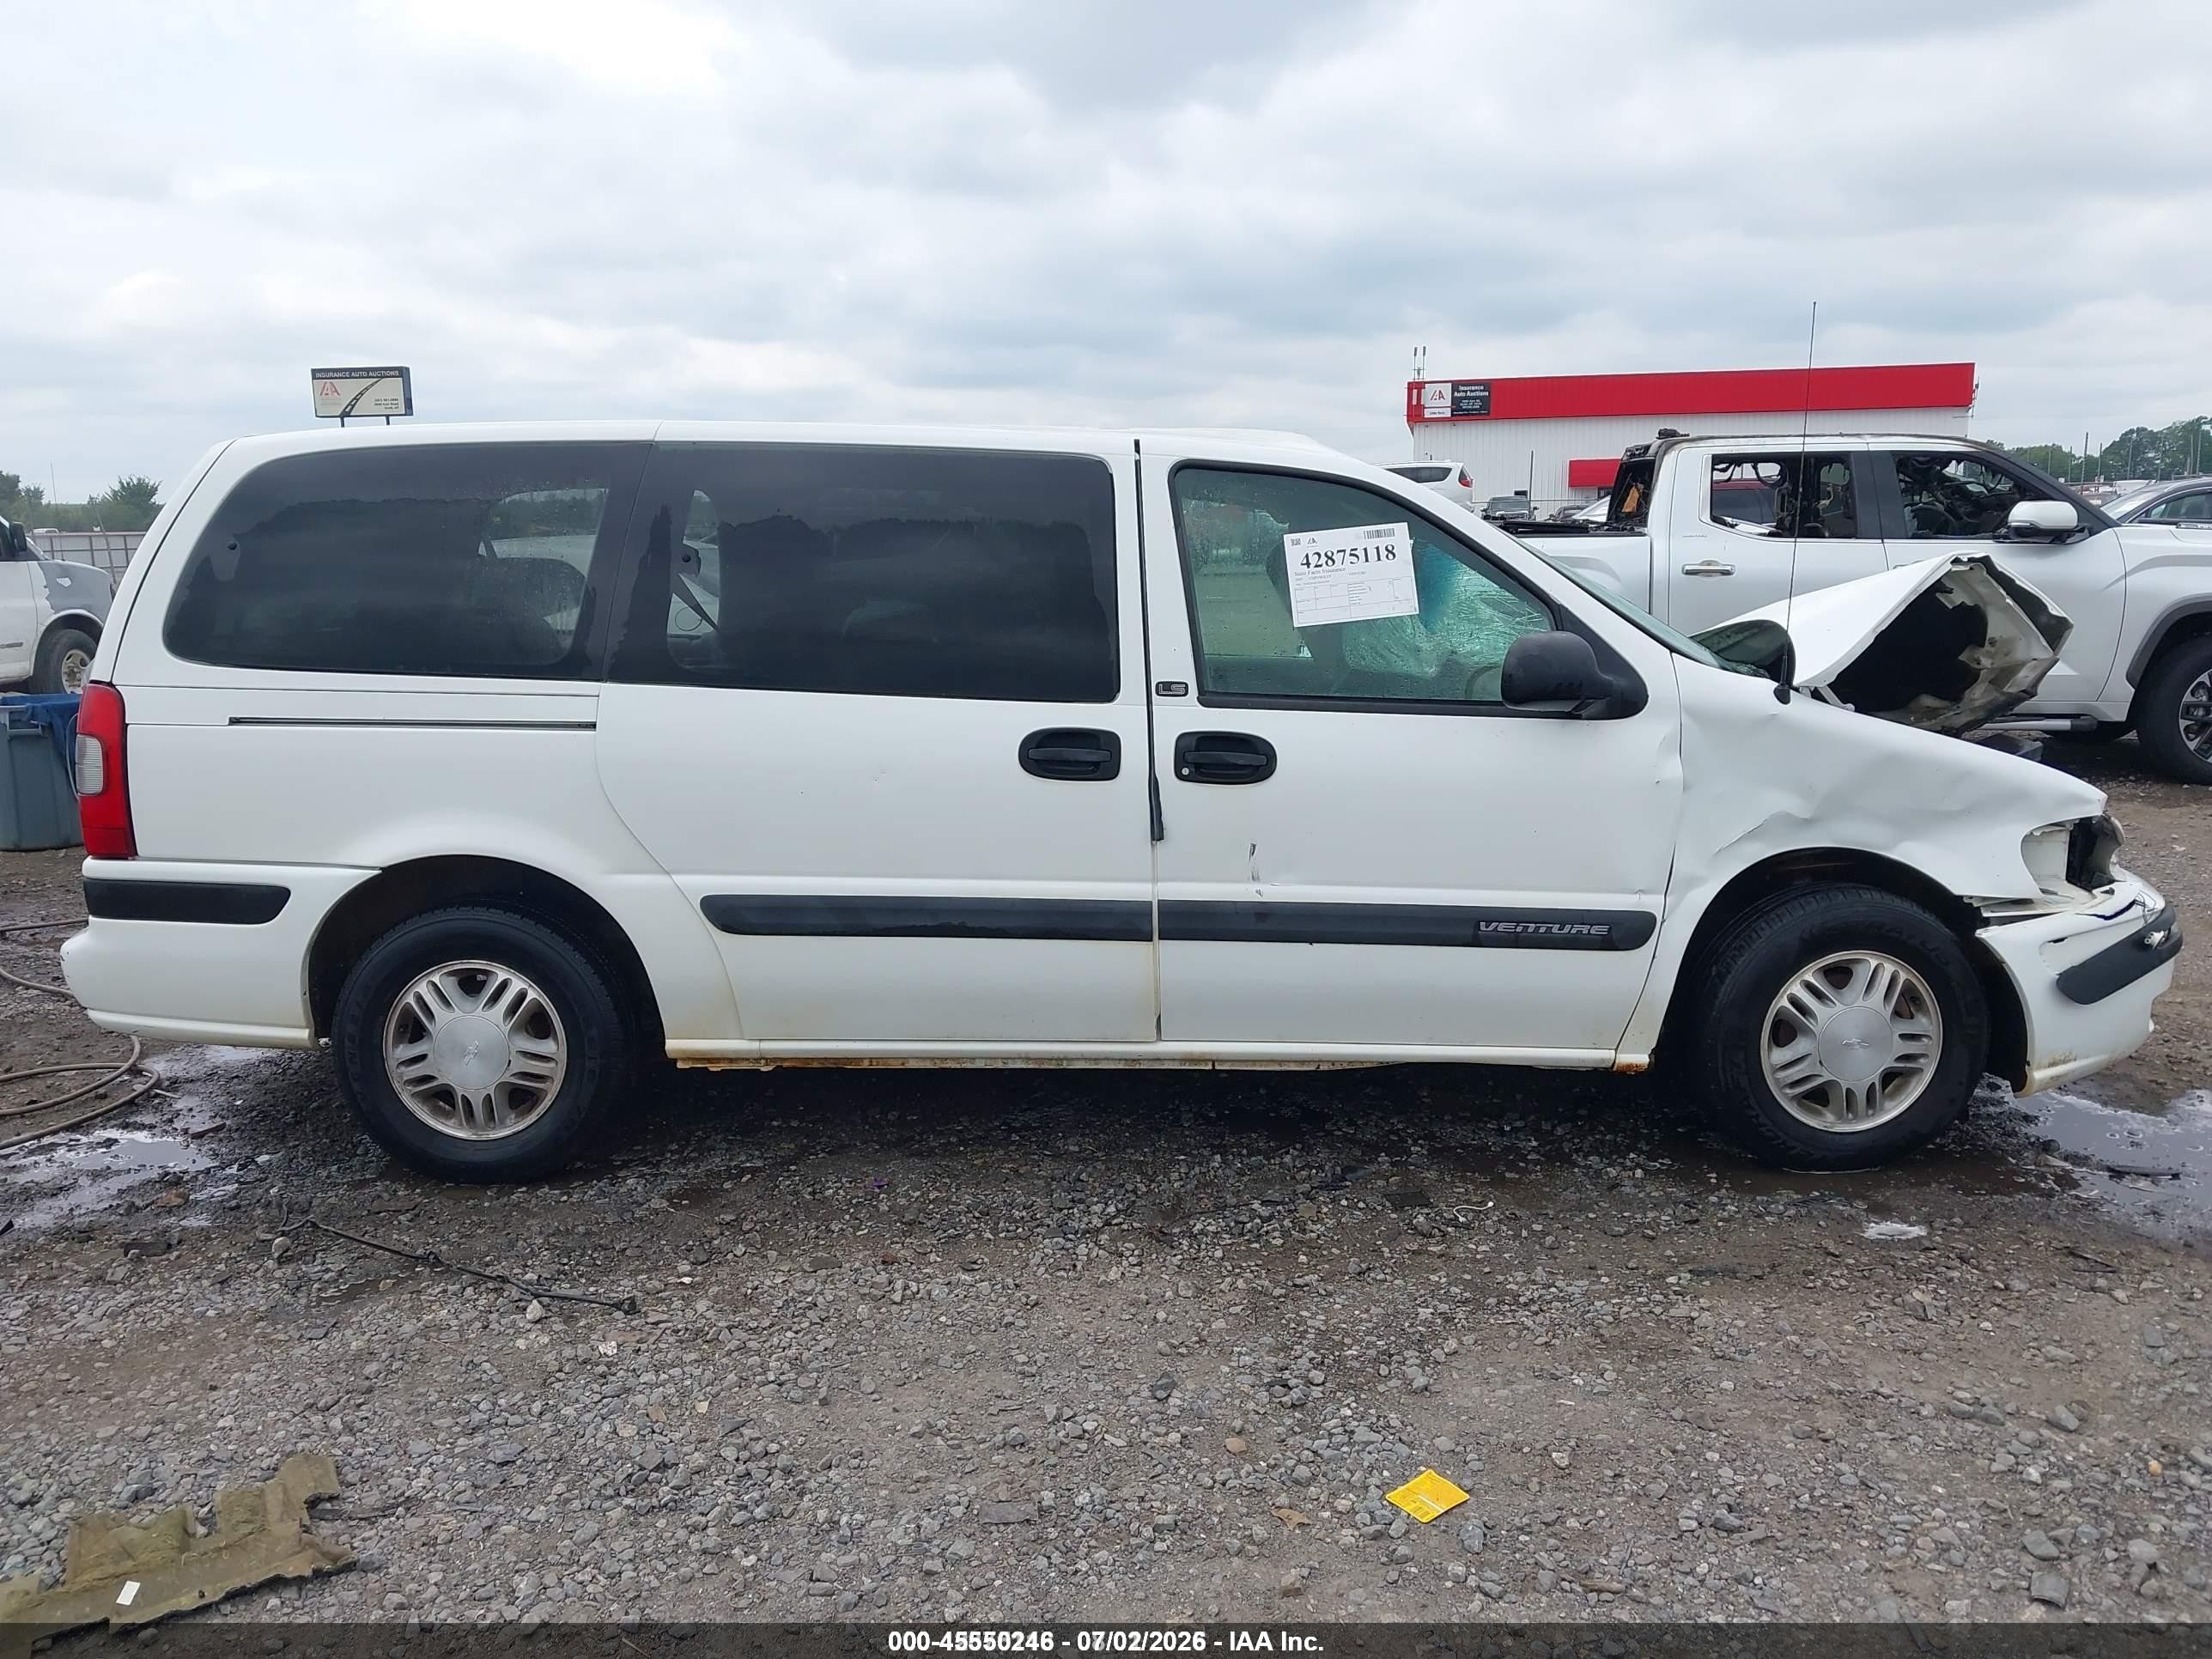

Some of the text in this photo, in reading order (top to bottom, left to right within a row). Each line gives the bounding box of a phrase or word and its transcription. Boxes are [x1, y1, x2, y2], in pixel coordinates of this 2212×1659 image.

[1300, 544, 1396, 569] 42875118
[1158, 684, 1186, 696] LS
[1480, 921, 1610, 935] VENTURE
